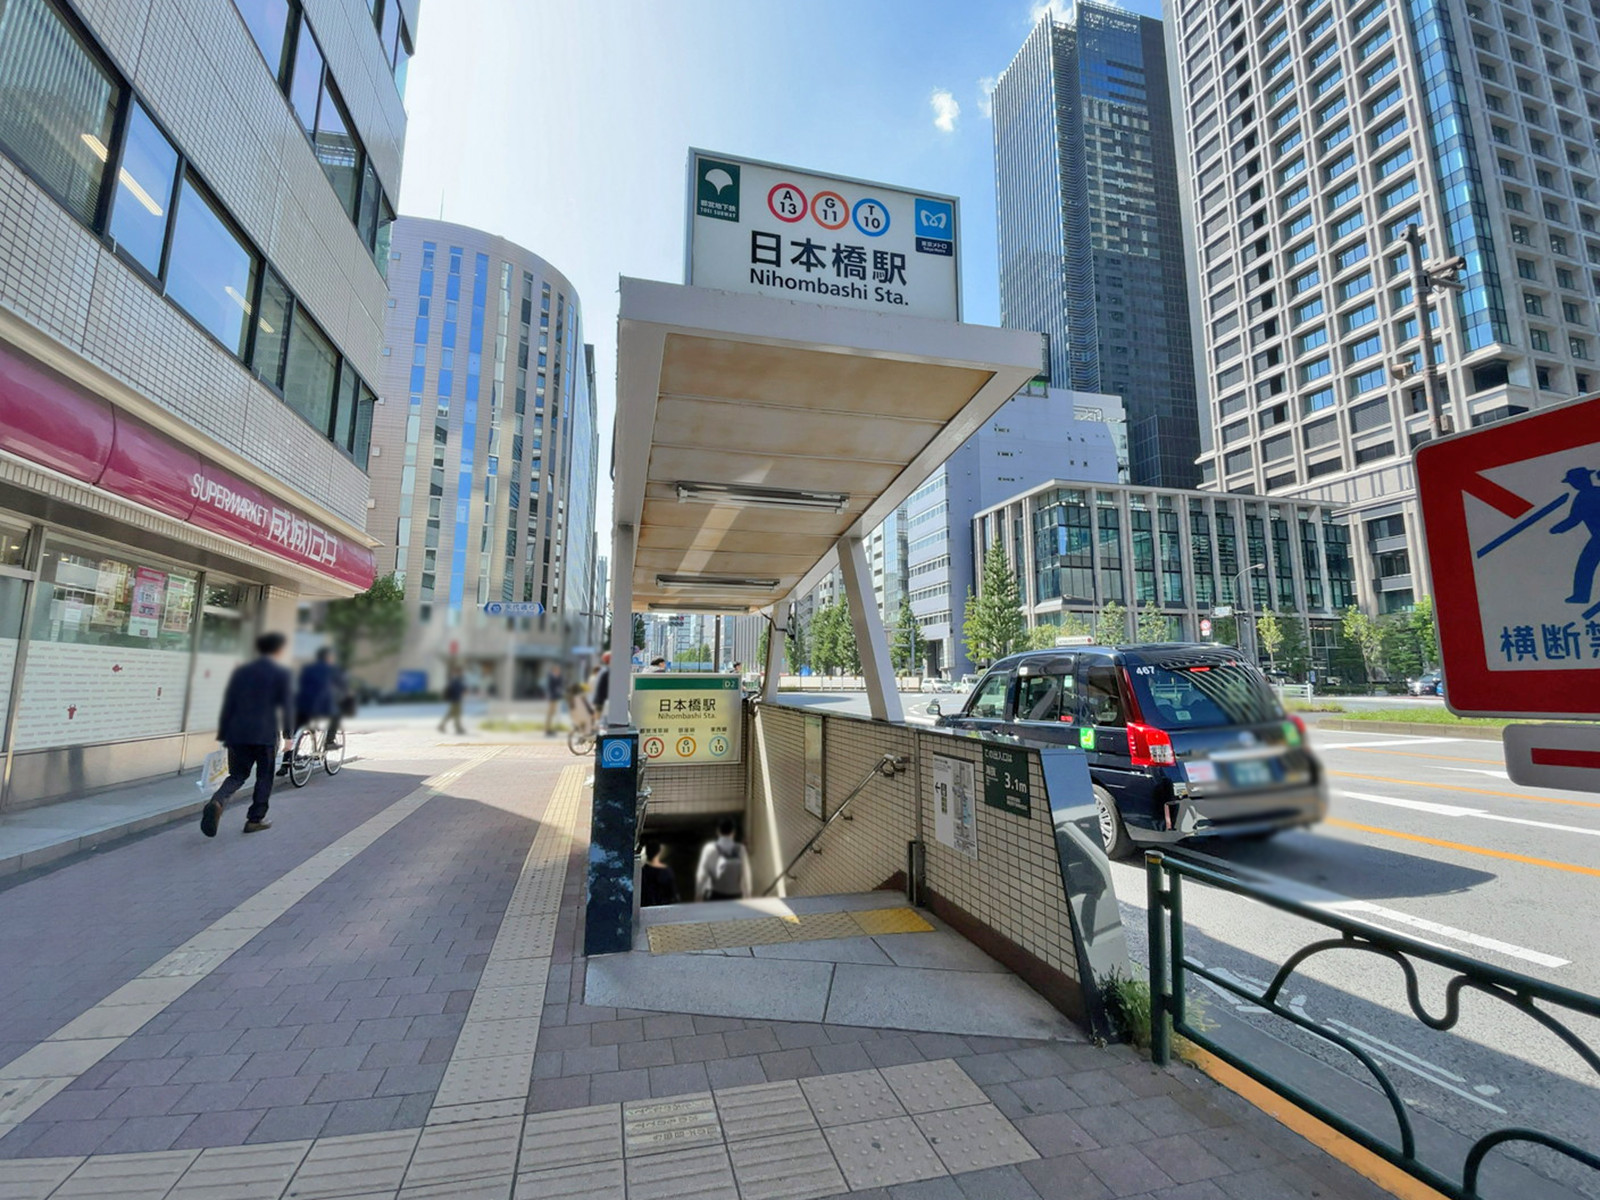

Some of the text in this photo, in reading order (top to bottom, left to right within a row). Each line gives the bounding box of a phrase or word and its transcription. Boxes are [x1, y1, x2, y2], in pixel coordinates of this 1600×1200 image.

[783, 190, 794, 201] A
[779, 202, 798, 215] 13
[825, 197, 836, 209] G
[822, 209, 838, 222] 11
[868, 205, 875, 216] T
[863, 216, 881, 229] 10
[751, 230, 907, 286] 日本橋駅
[750, 268, 909, 306] Nihombashi Sta.
[191, 473, 338, 567] SUPERMARKET 成城石井
[1136, 666, 1155, 676] 467
[660, 698, 716, 712] 日本橋駅
[1004, 772, 1027, 793] 3.1m
